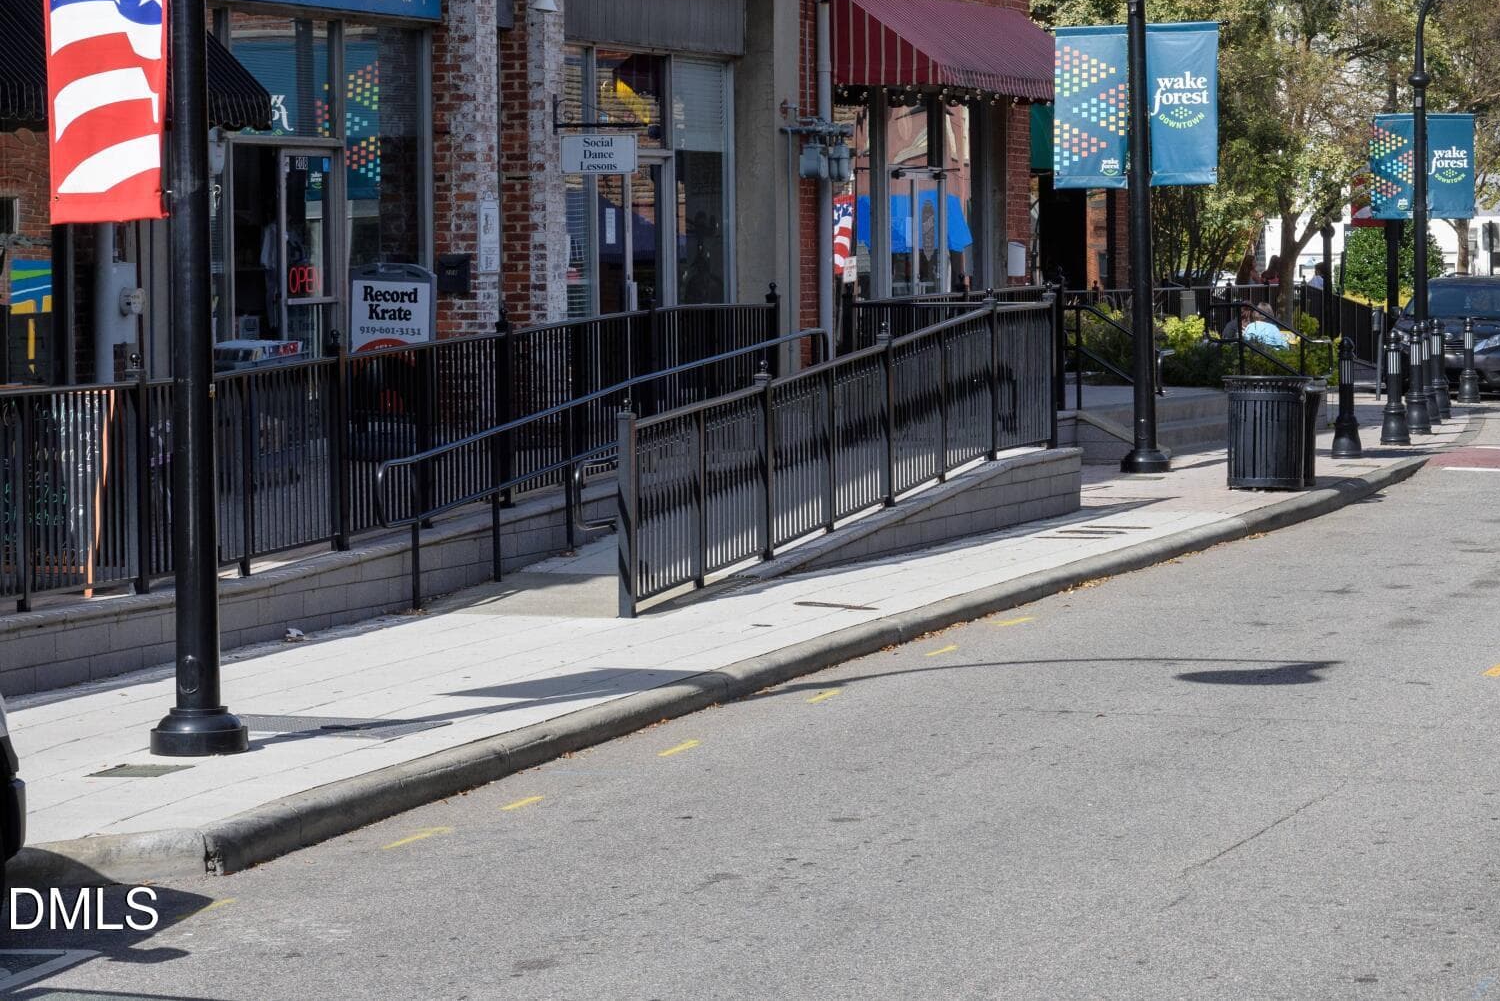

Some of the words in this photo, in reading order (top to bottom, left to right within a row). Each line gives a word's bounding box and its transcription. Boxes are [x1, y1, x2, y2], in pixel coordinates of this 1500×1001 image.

[1156, 71, 1208, 90] wake
[1151, 88, 1209, 116] forest
[1158, 112, 1206, 129] DOWNTOWN
[583, 137, 613, 148] Social
[583, 149, 614, 159] Dance
[1433, 146, 1468, 158] wake
[580, 161, 617, 171] Lessons
[1428, 157, 1469, 175] forest
[363, 285, 418, 303] Record
[368, 303, 412, 321] Krate
